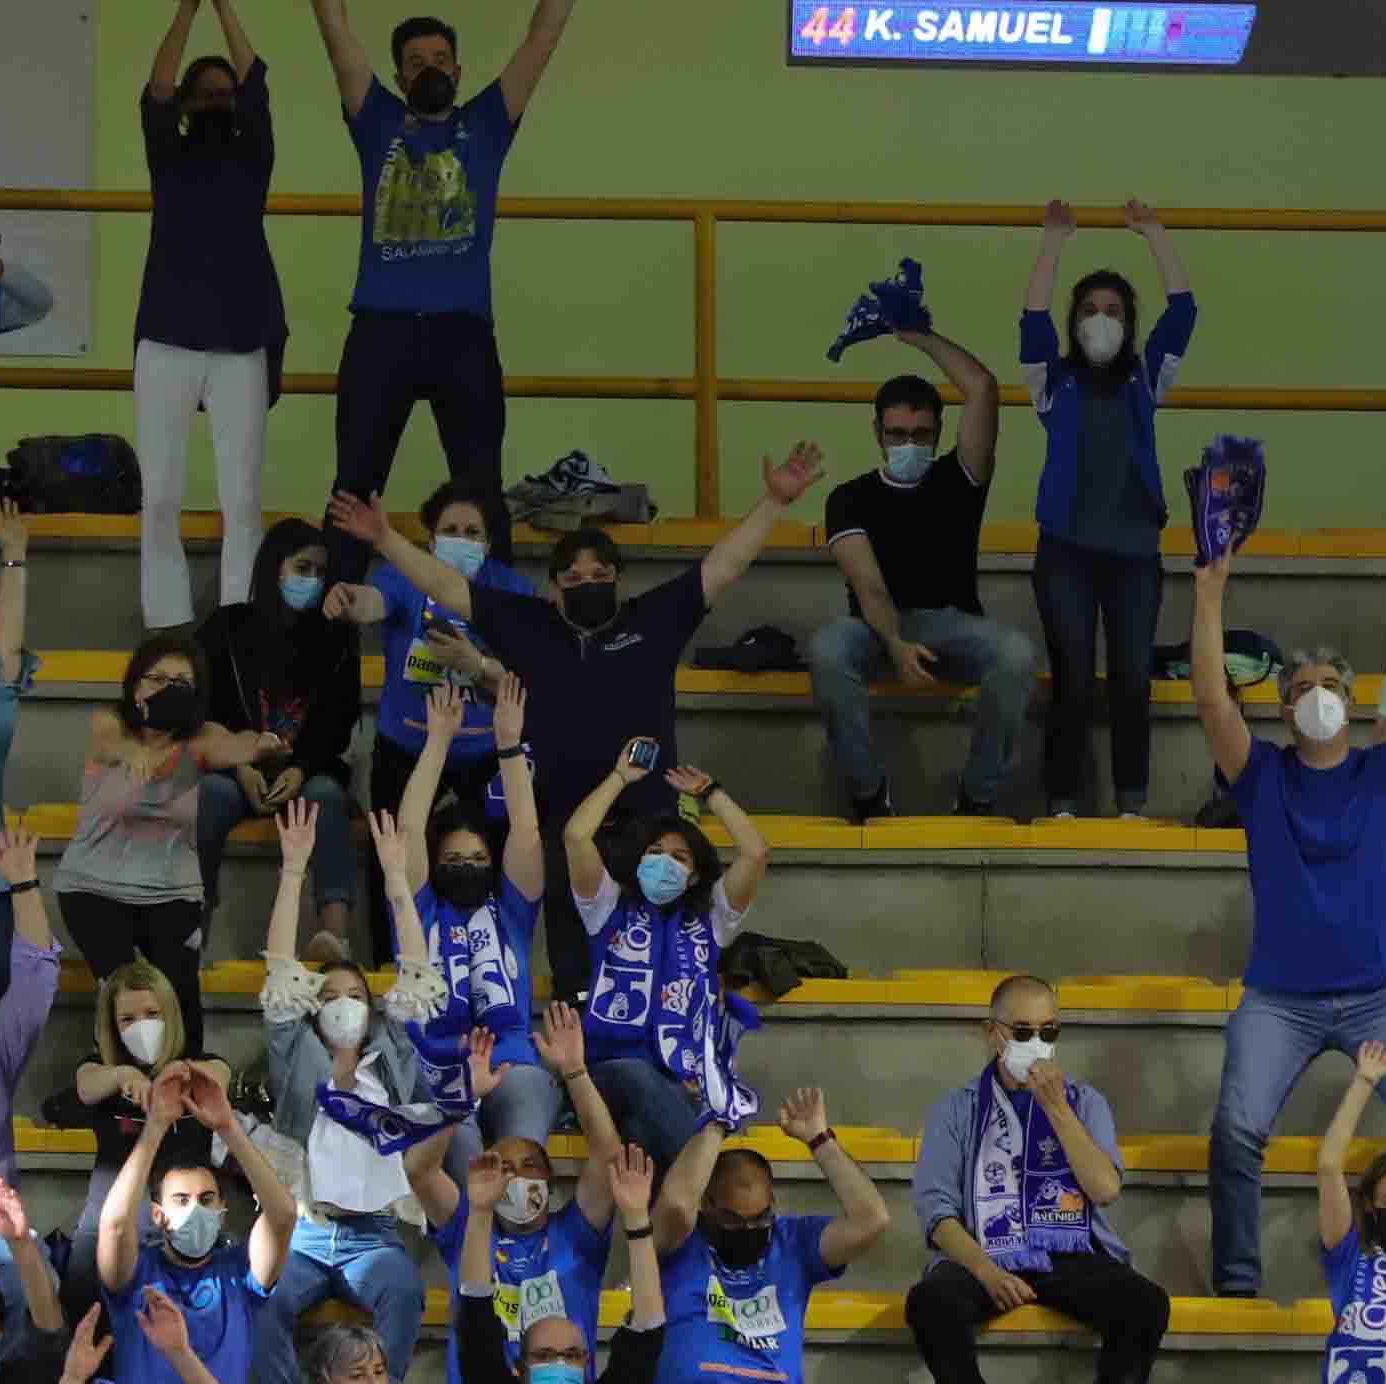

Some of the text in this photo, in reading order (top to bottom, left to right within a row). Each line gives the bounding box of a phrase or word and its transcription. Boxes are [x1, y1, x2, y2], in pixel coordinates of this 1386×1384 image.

[800, 8, 1073, 44] 44 K. SAMUEL
